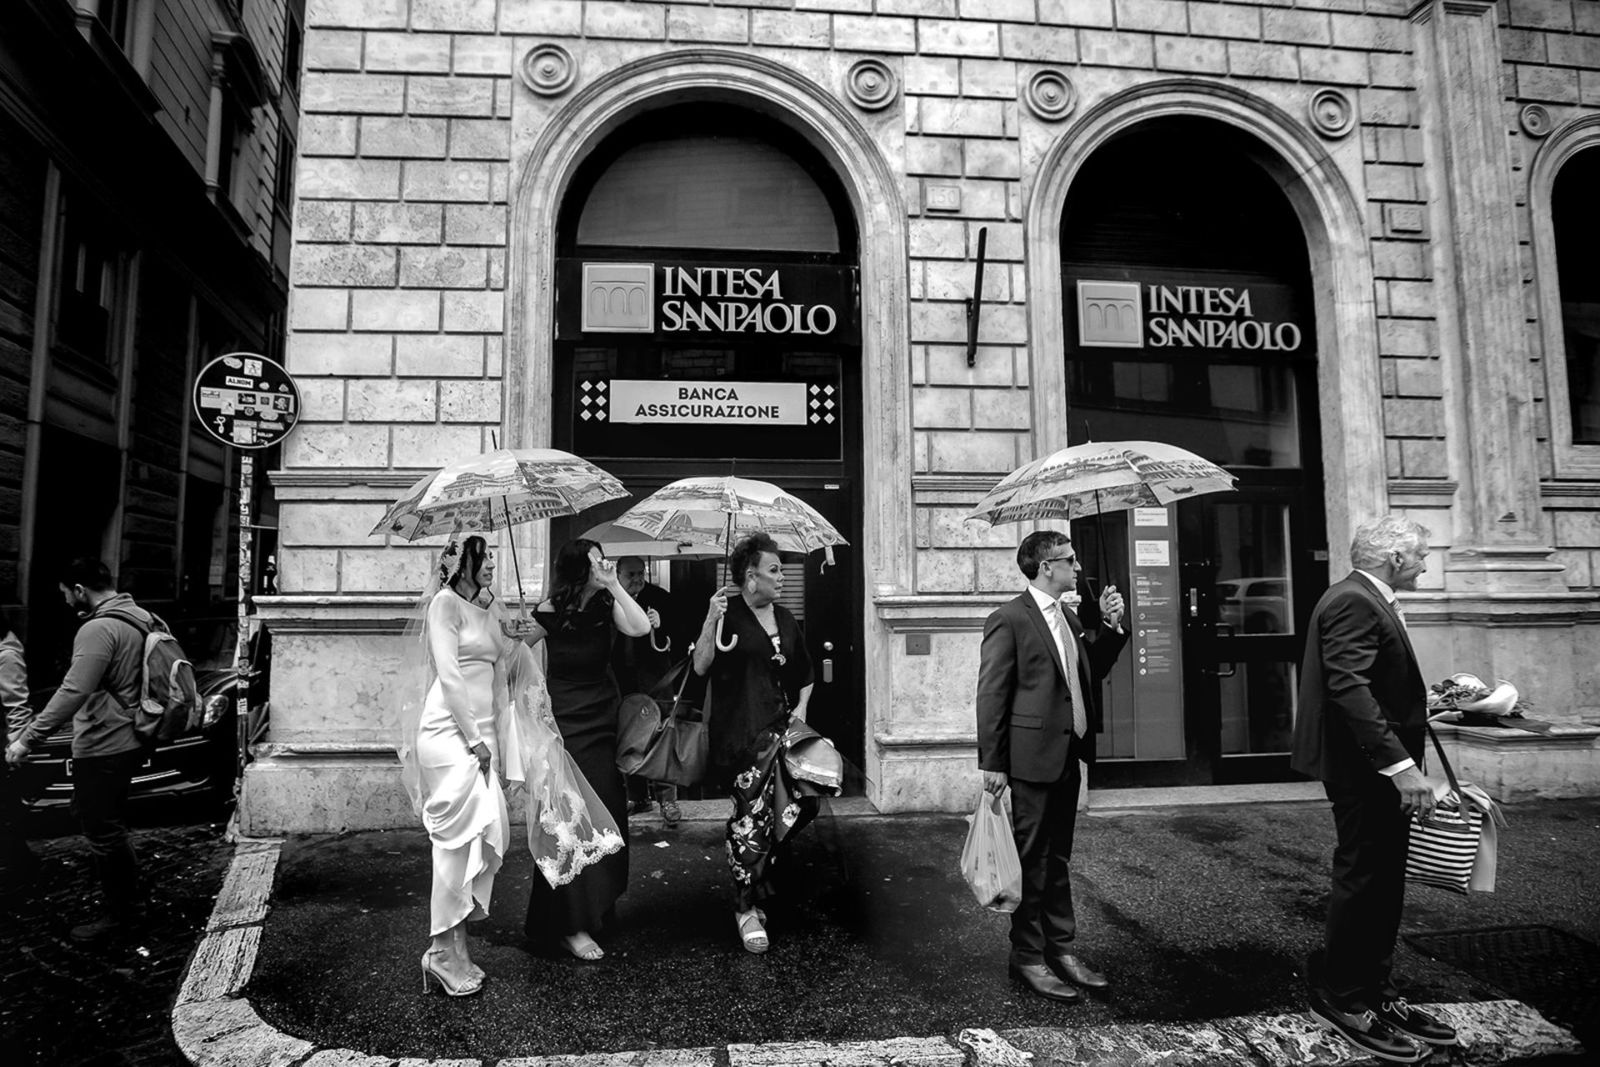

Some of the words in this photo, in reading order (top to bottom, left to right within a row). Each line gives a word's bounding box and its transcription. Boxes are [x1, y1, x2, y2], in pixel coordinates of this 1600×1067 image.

[662, 266, 784, 299] INTESA
[1148, 284, 1254, 317] INTESA
[661, 301, 837, 335] SANPAOLO
[1149, 317, 1301, 351] SANPAOLO
[678, 387, 739, 401] BANCA
[635, 404, 780, 418] ASSICURAZIONE
